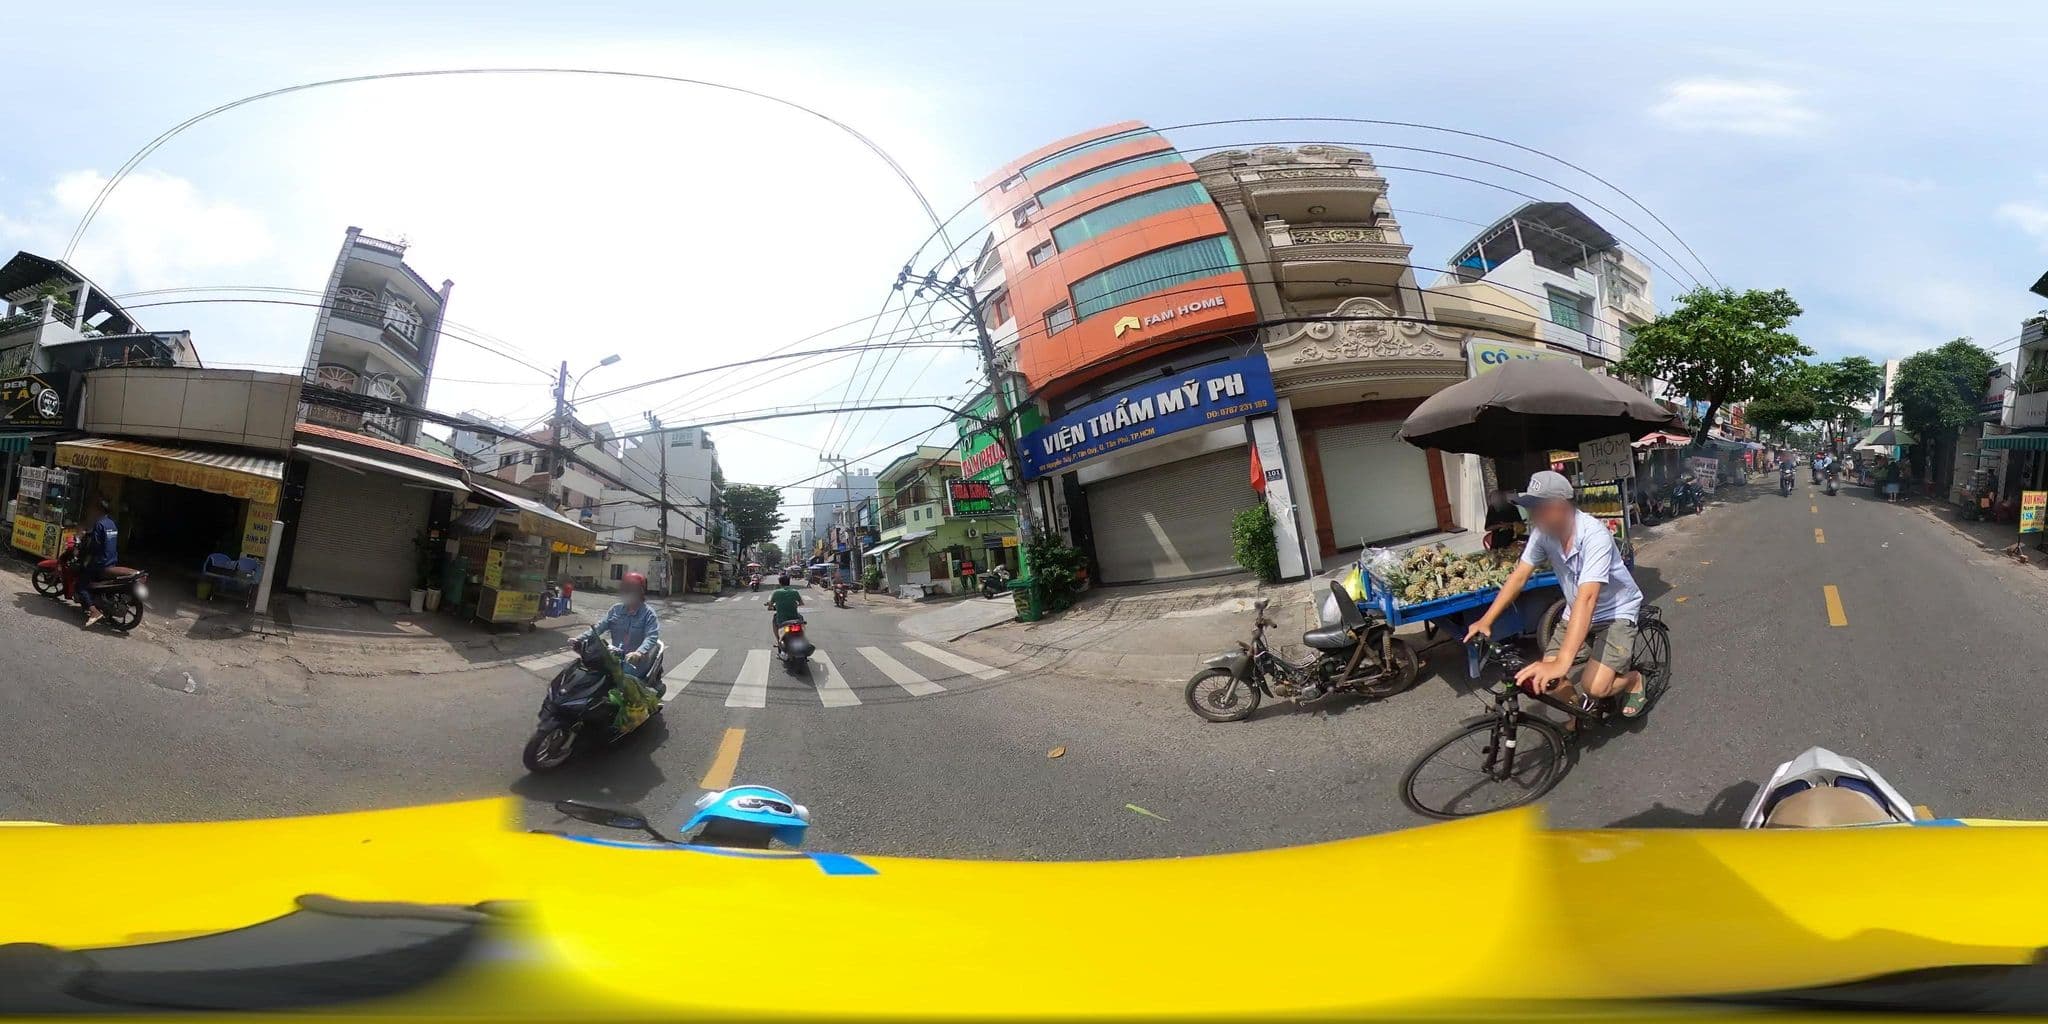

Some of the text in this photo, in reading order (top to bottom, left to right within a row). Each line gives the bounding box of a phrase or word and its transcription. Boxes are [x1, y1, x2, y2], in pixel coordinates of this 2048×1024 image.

[1144, 296, 1224, 326] FAM HOME
[1042, 373, 1245, 455] VIỆN THẨM MỸ PH
